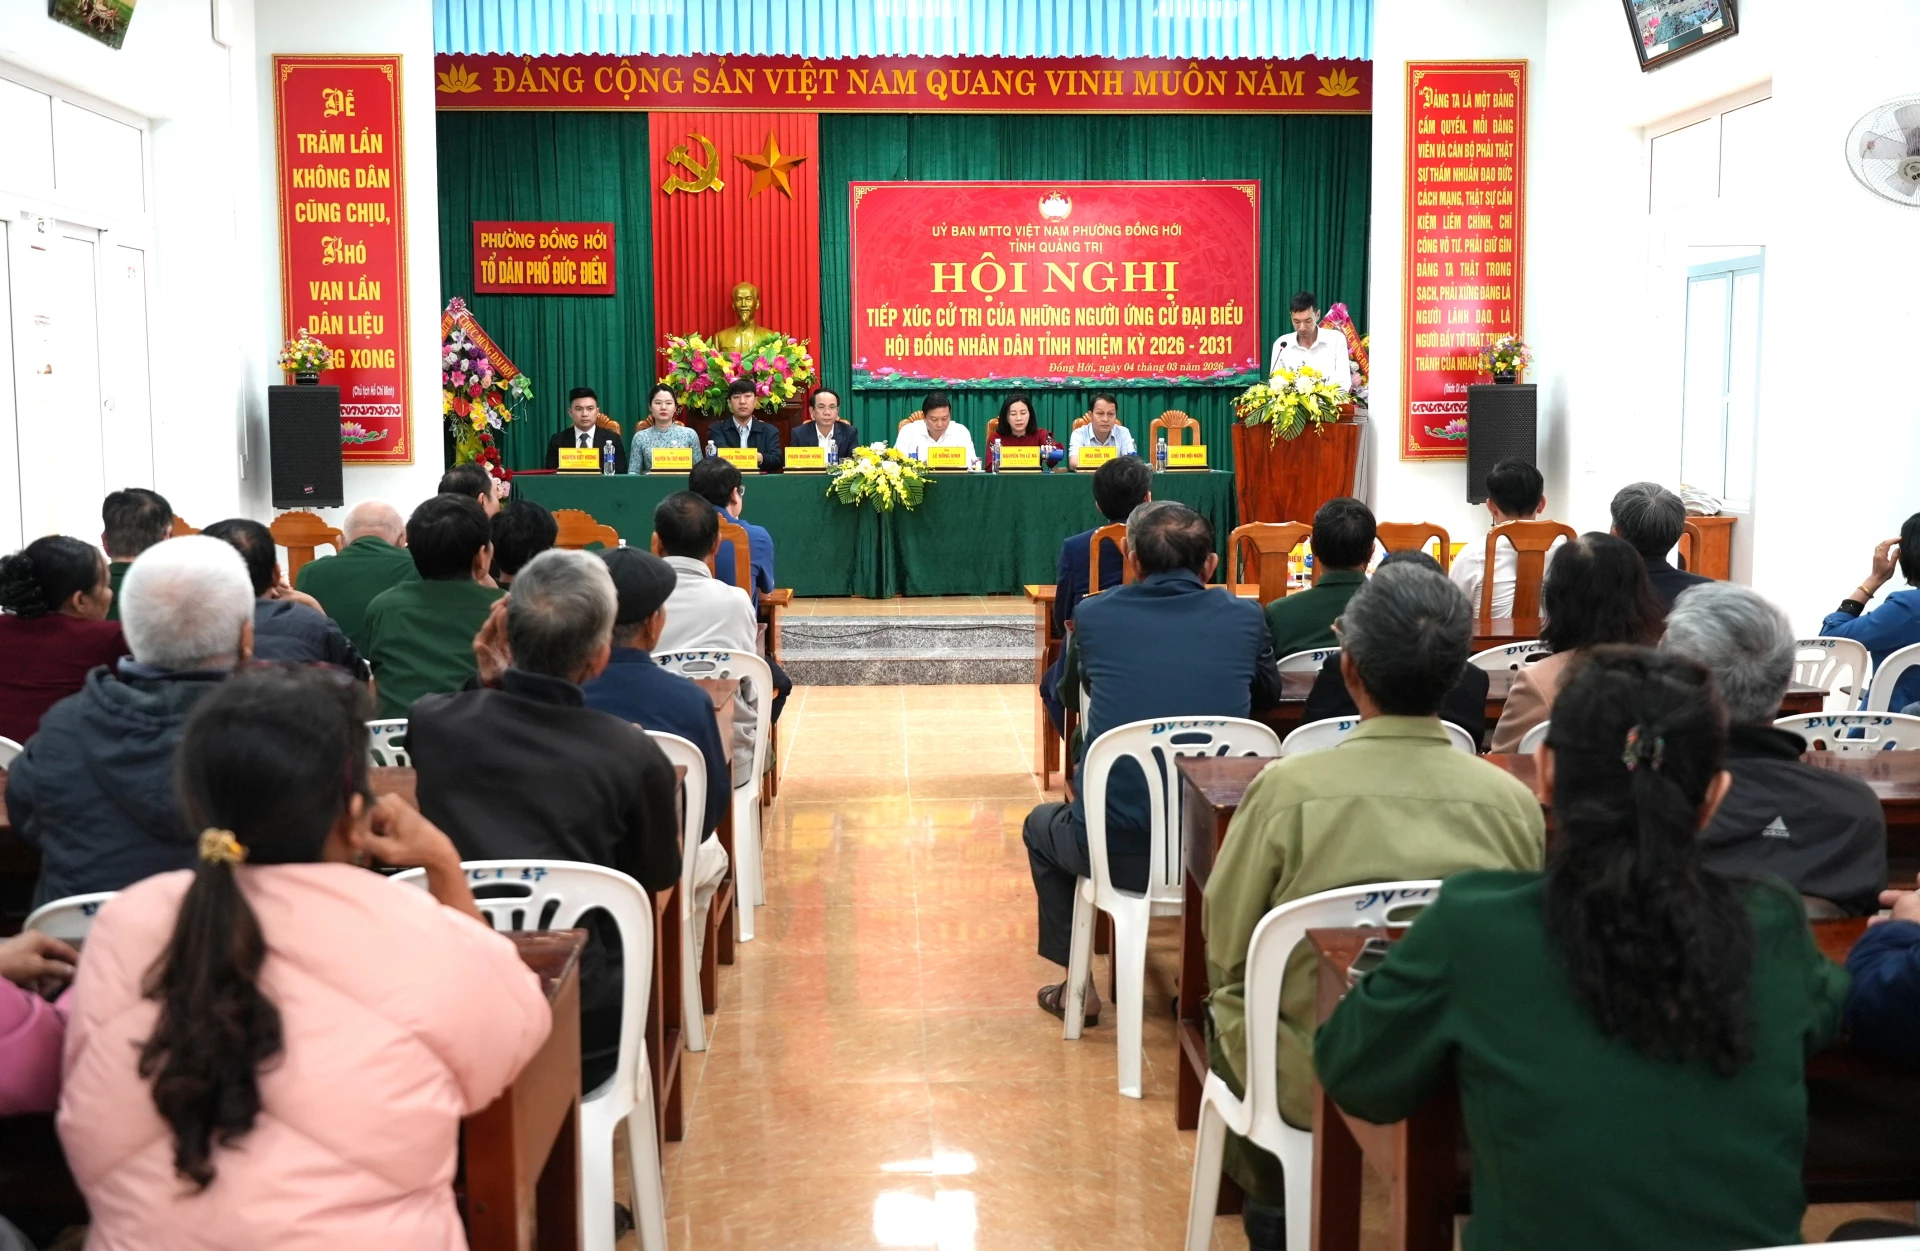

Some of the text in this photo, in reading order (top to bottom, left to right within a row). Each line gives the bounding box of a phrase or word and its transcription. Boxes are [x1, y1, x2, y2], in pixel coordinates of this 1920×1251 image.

[493, 57, 1304, 101] ĐẢNG CỘNG SẢN VIỆT NAM QUANG VINH MUÔN NĂM
[1452, 94, 1460, 108] TA
[1463, 90, 1472, 108] LÀ
[1475, 90, 1491, 111] MỘT
[1493, 89, 1514, 108] ĐẢNG
[1418, 114, 1513, 135] CẦM QUYỀN. MỖI ĐẢNG
[297, 127, 382, 153] TRĂM LẦN
[1418, 139, 1513, 161] VIÊN VÀ CÁN BỘ PHẢI THẬT
[293, 164, 390, 188] KHÔNG DÂN
[1418, 162, 1512, 185] SỰ THẤM NHUẦN ĐẠO ĐỨC
[1418, 186, 1512, 209] CÁCH MẠNG, THẬT SỰ CẦN
[295, 199, 390, 227] CŨNG CHỊU,
[1418, 212, 1512, 233] KIỆM LIÊM CHÍNH, CHÍ
[481, 227, 607, 249] PHƯỜNG ĐỒNG HỚI
[932, 221, 1182, 240] UỶ BAN MTTQ VIỆT NAM PHƯỜNG ĐỒNG HỚI
[321, 236, 366, 266] KHÓ
[1009, 238, 1102, 254] TỈNH QUẢNG TRỊ
[1417, 234, 1511, 253] CÔNG VÔ TƯ. PHẢI GIỮ GÌN
[481, 252, 606, 284] TỔ DÂN PHỐ ĐỨC ĐIỀN
[930, 252, 1179, 302] HỘI NGHỊ
[1417, 258, 1511, 279] ĐẢNG TA THẬT TRONG
[309, 274, 380, 305] VẠN LẦN
[1417, 281, 1511, 304] SẠCH, PHẢI XỨNG ĐÁNG LÀ
[308, 311, 384, 339] DÂN LIỆU
[867, 299, 1243, 329] TIẾP XÚC CỬ TRI CỦA NHỮNG NGƯỜI ỨNG CỬ ĐẠI BIỂU
[1416, 307, 1510, 326] NGƯỜI LÃNH ĐẠO, LÀ
[885, 334, 909, 360] HỘI
[914, 331, 953, 356] ĐỒNG
[959, 333, 998, 356] NHÂN
[1003, 333, 1033, 356] DÂN
[1038, 331, 1070, 355] TỈNH
[1076, 332, 1122, 359] NHIỆM
[1127, 333, 1145, 355] KỲ
[1150, 336, 1184, 354] 2026
[1199, 336, 1232, 354] 2031
[350, 349, 395, 368] XONG
[1050, 362, 1224, 372] Đồng Hới, ngày 04 tháng 03 năm 2026
[1416, 352, 1477, 371] THÀNH CỦA NHÂN
